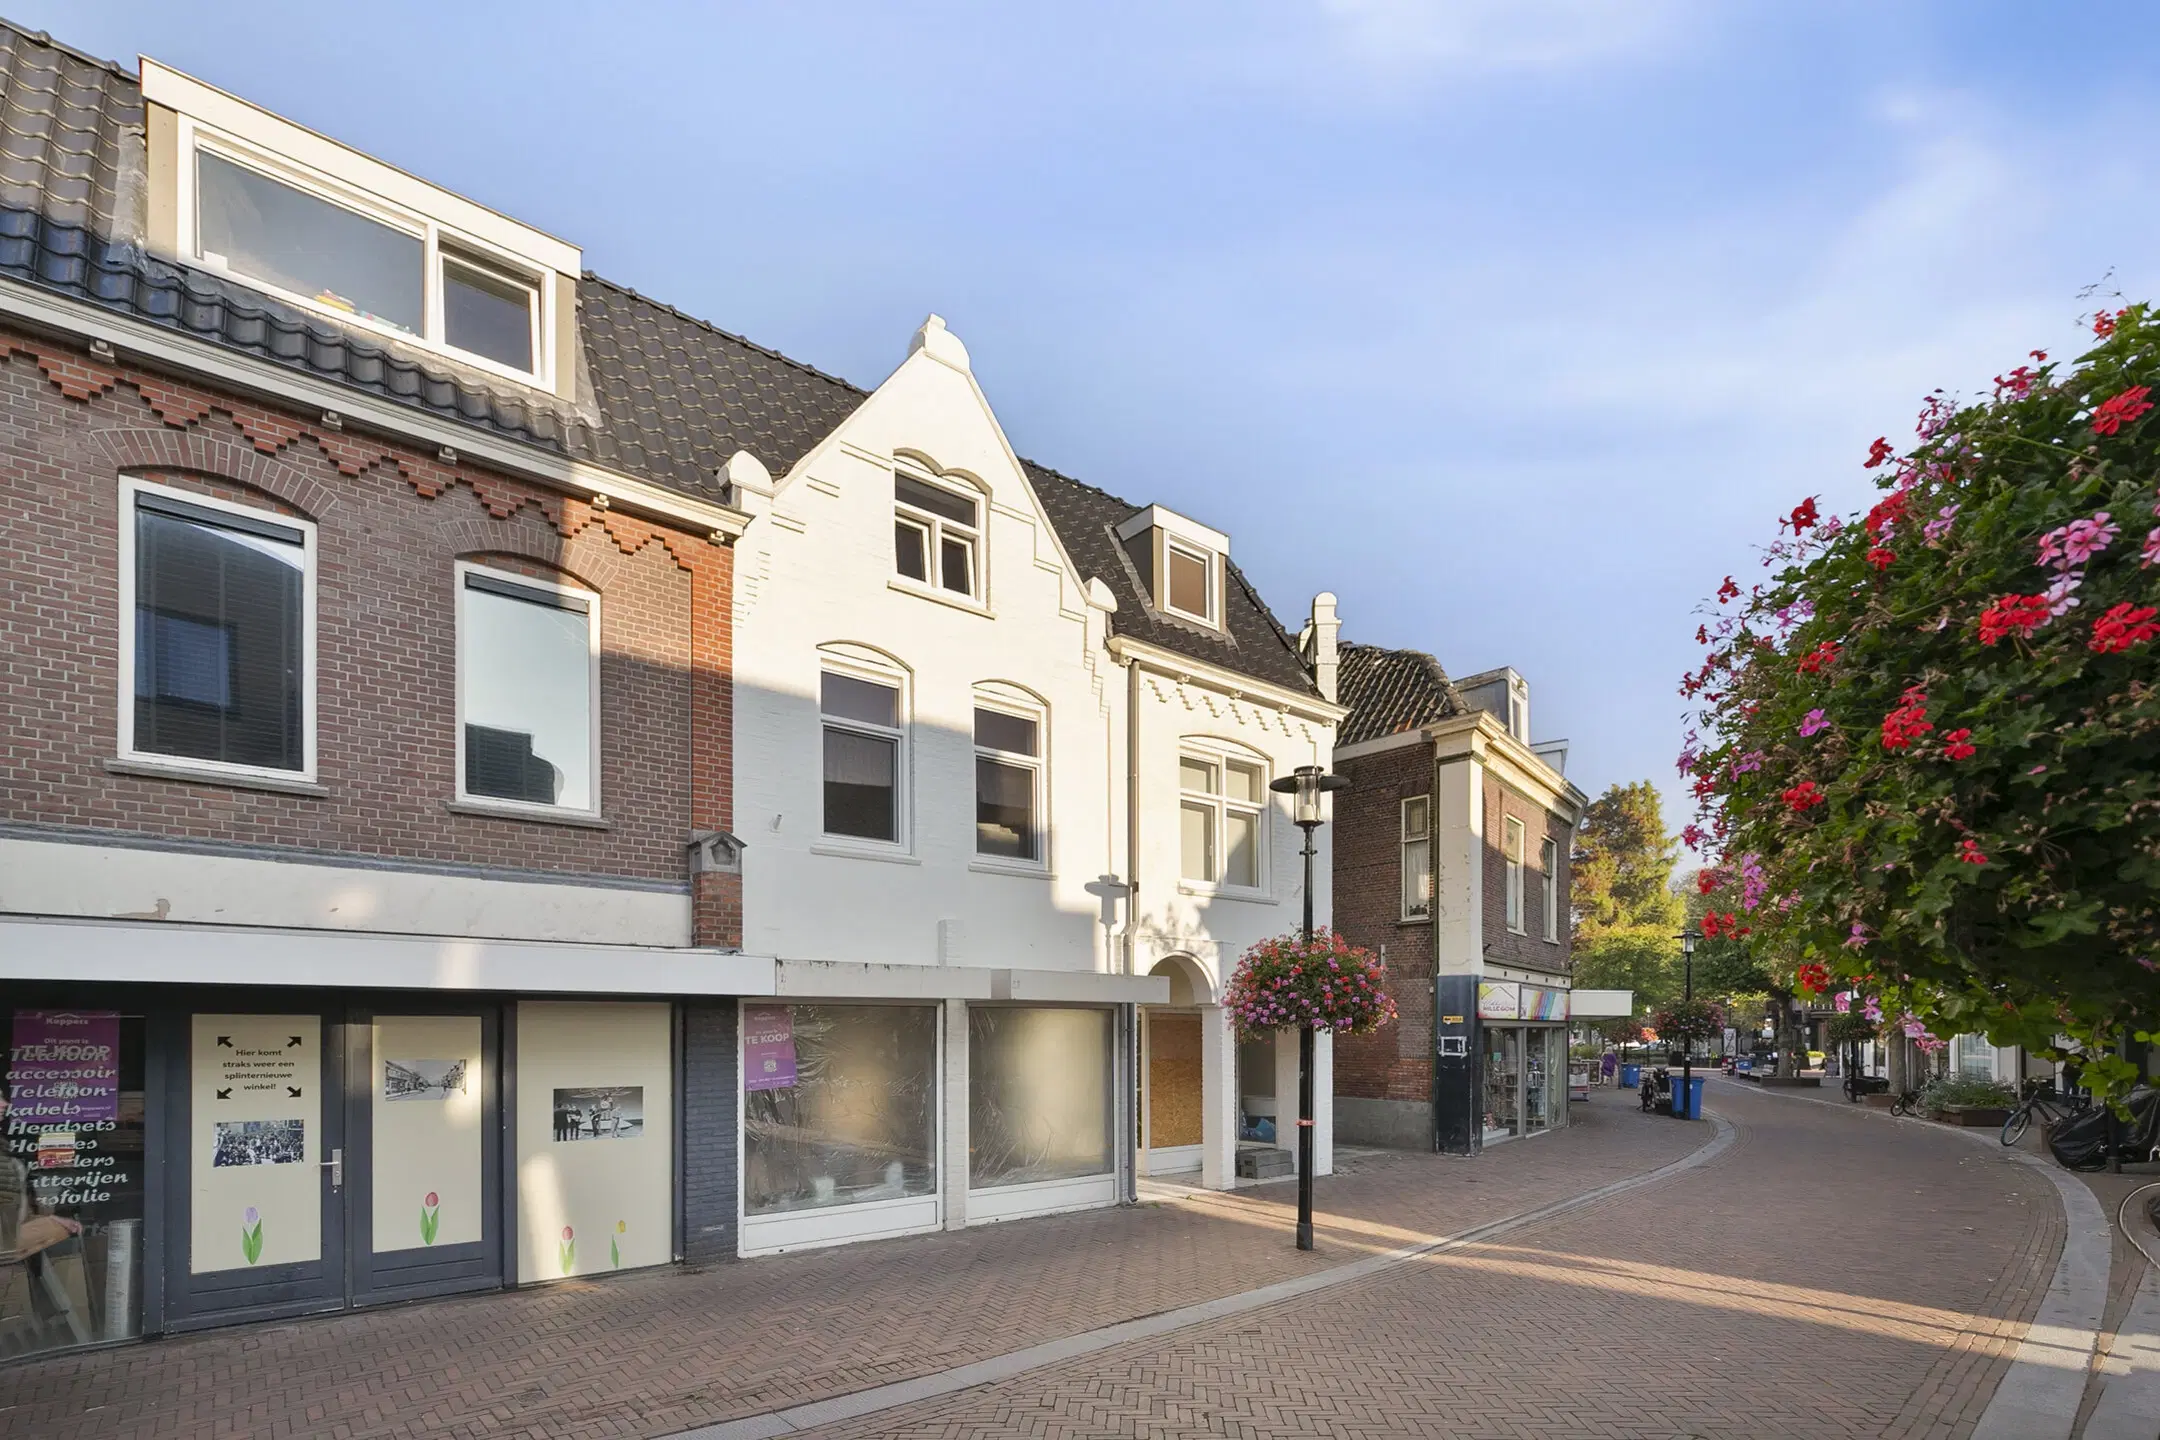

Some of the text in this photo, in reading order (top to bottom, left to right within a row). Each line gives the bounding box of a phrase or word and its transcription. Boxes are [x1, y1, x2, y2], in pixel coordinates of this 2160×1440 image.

[745, 1033, 790, 1045] TE KOOP
[224, 1072, 293, 1080] splinternieuwe
[5, 1101, 81, 1117] kabels
[7, 1119, 117, 1135] Headsets
